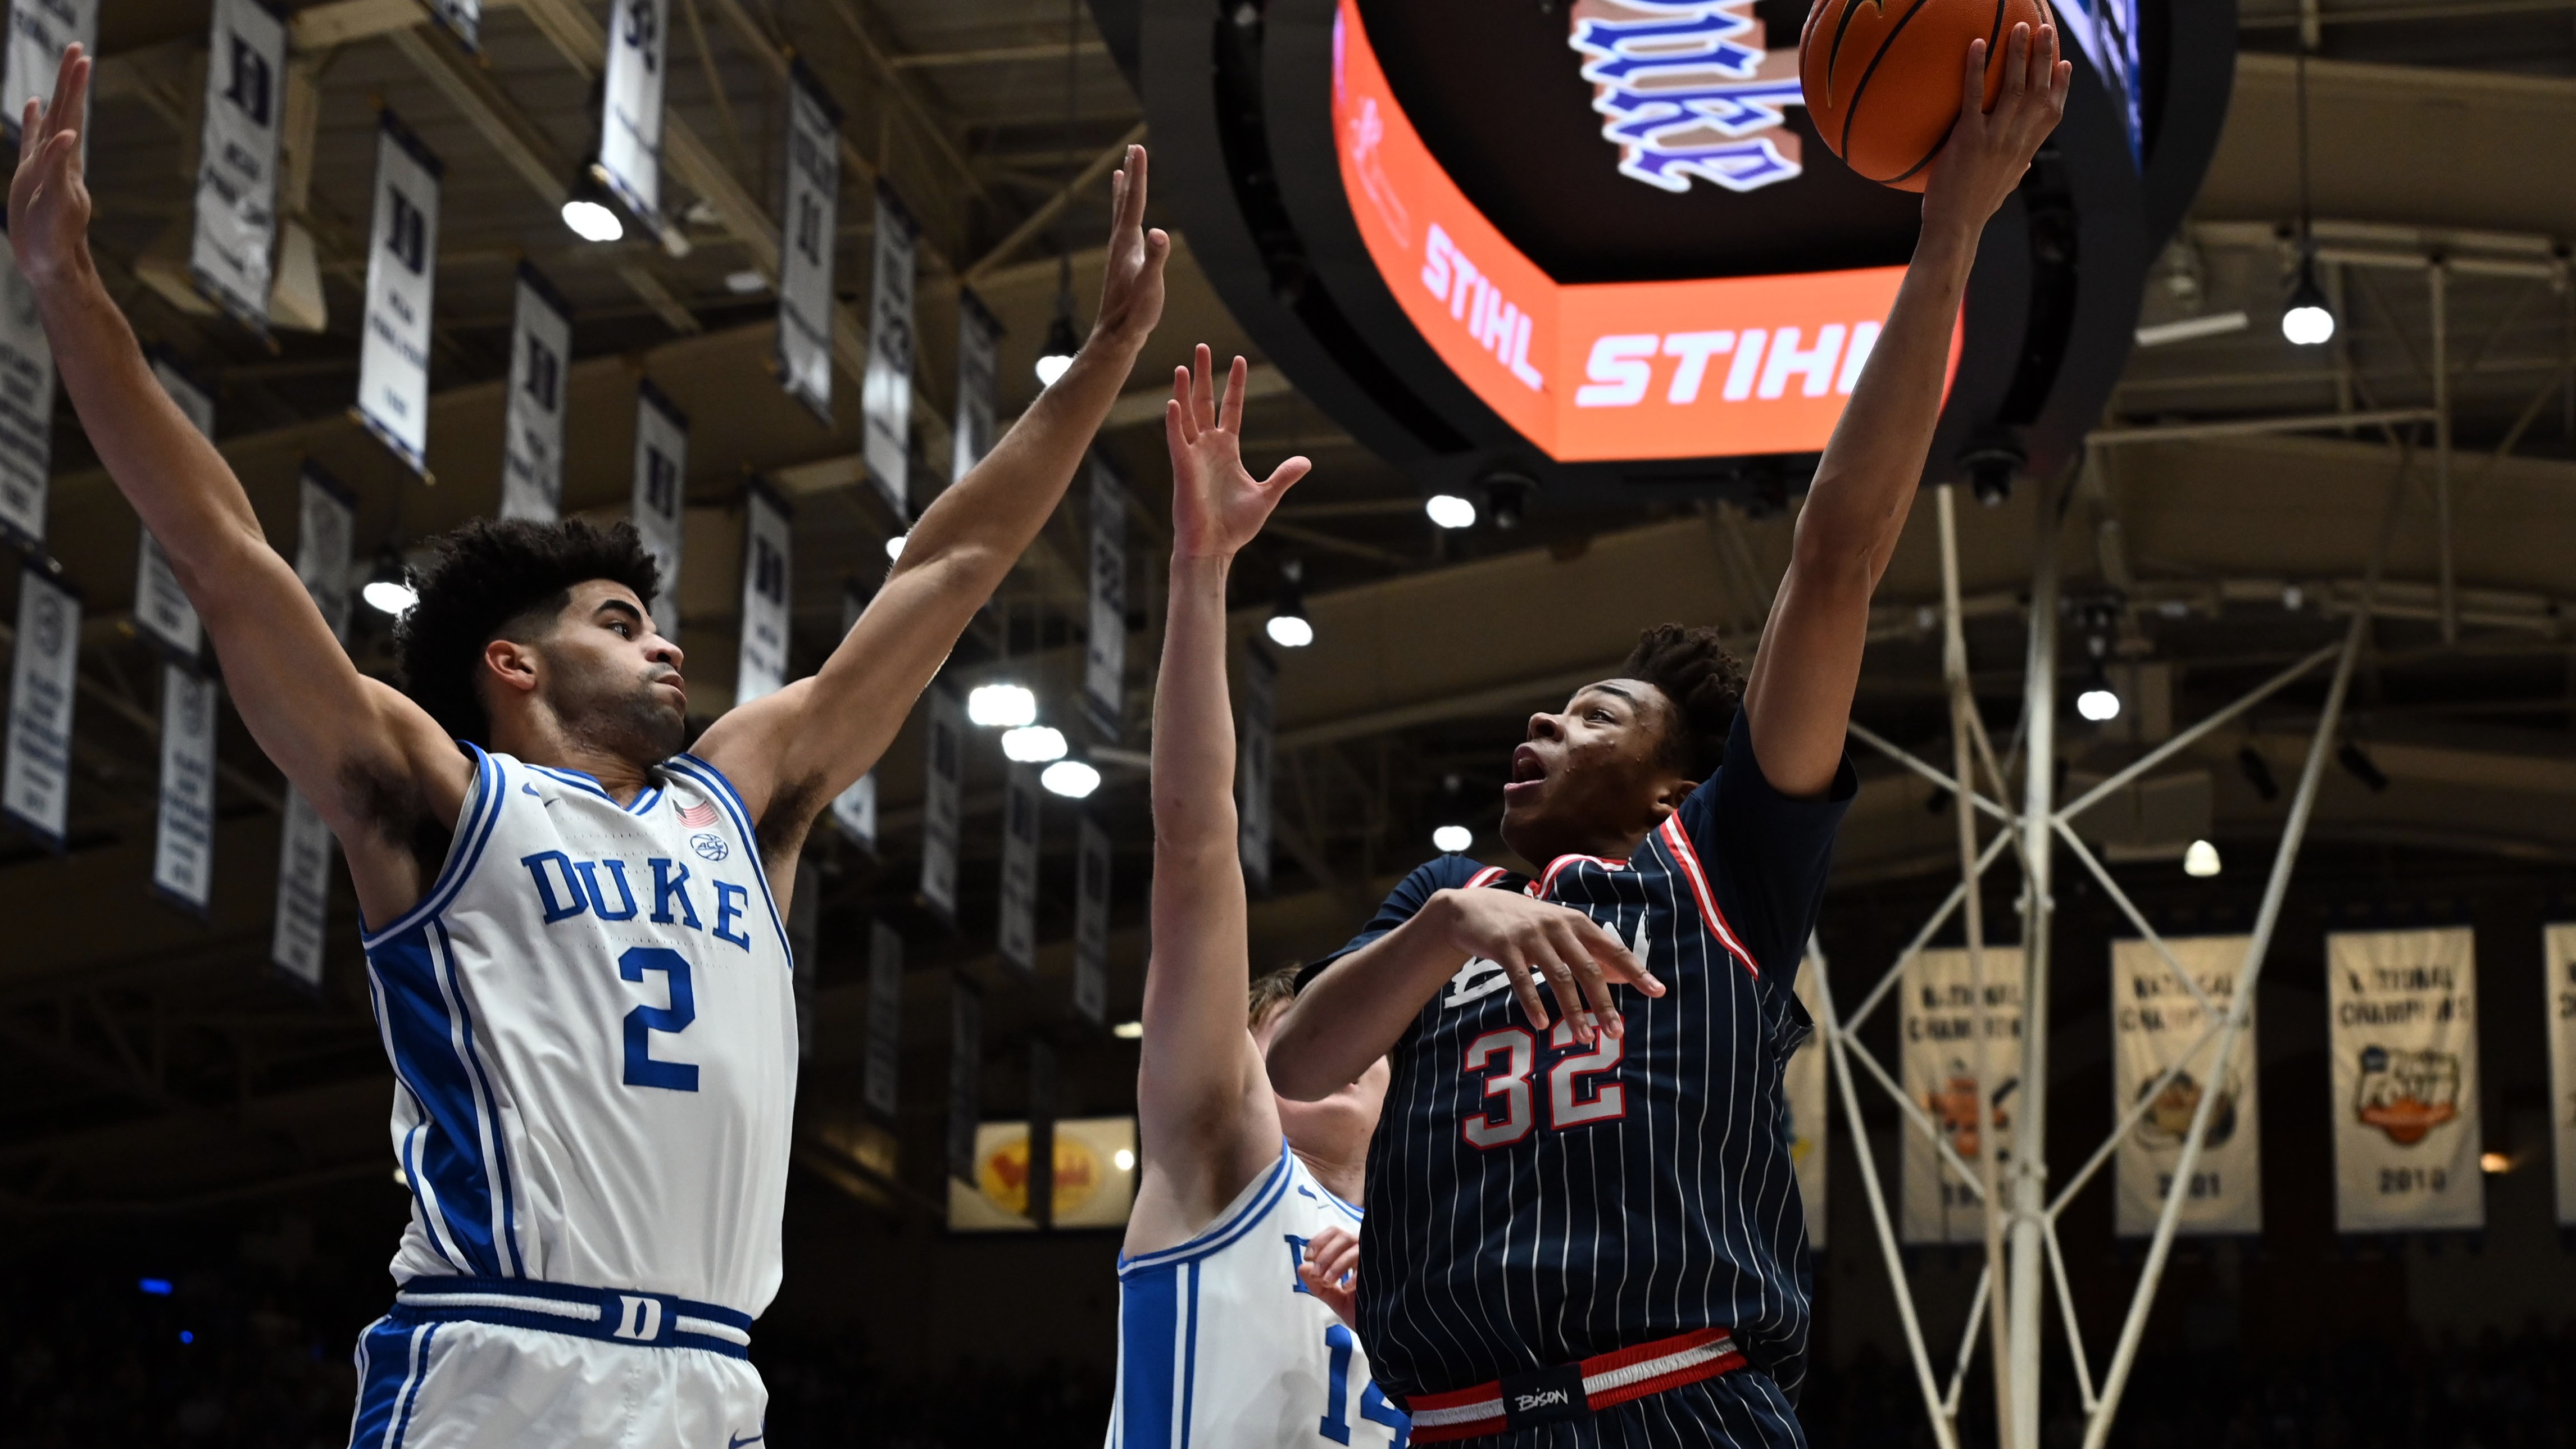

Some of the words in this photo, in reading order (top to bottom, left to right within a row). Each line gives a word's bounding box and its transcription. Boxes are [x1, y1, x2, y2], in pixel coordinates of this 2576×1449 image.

[1568, 0, 1805, 193] uke
[1421, 223, 1544, 393] STIHL
[520, 850, 750, 953] DUKE
[618, 946, 699, 1092] 2
[1462, 1009, 1627, 1150] 32
[2156, 1170, 2221, 1199] 201
[612, 1295, 662, 1342] D
[1319, 1323, 1412, 1449] 14
